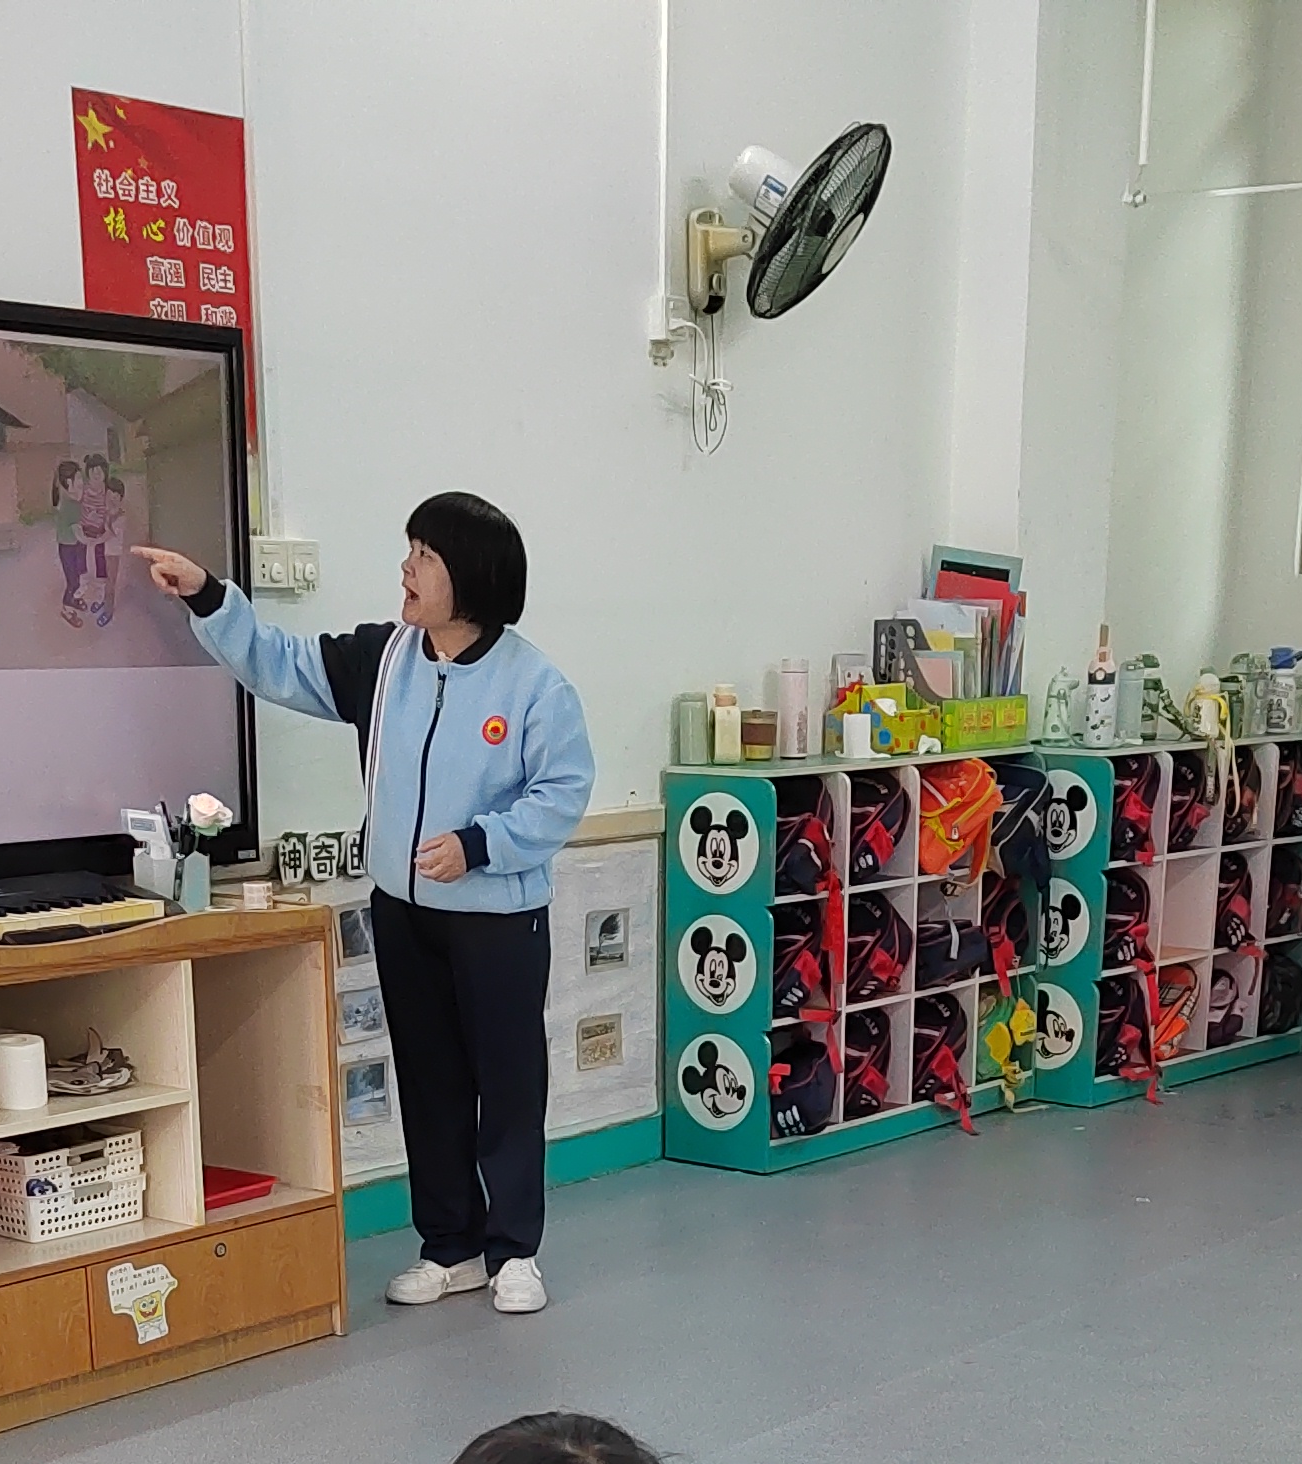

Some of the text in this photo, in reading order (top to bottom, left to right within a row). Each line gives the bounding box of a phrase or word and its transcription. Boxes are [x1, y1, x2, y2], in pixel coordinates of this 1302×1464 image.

[93, 168, 180, 208] 社会主义
[147, 256, 236, 294] 富强 民主
[149, 298, 237, 328] 文明 和谐
